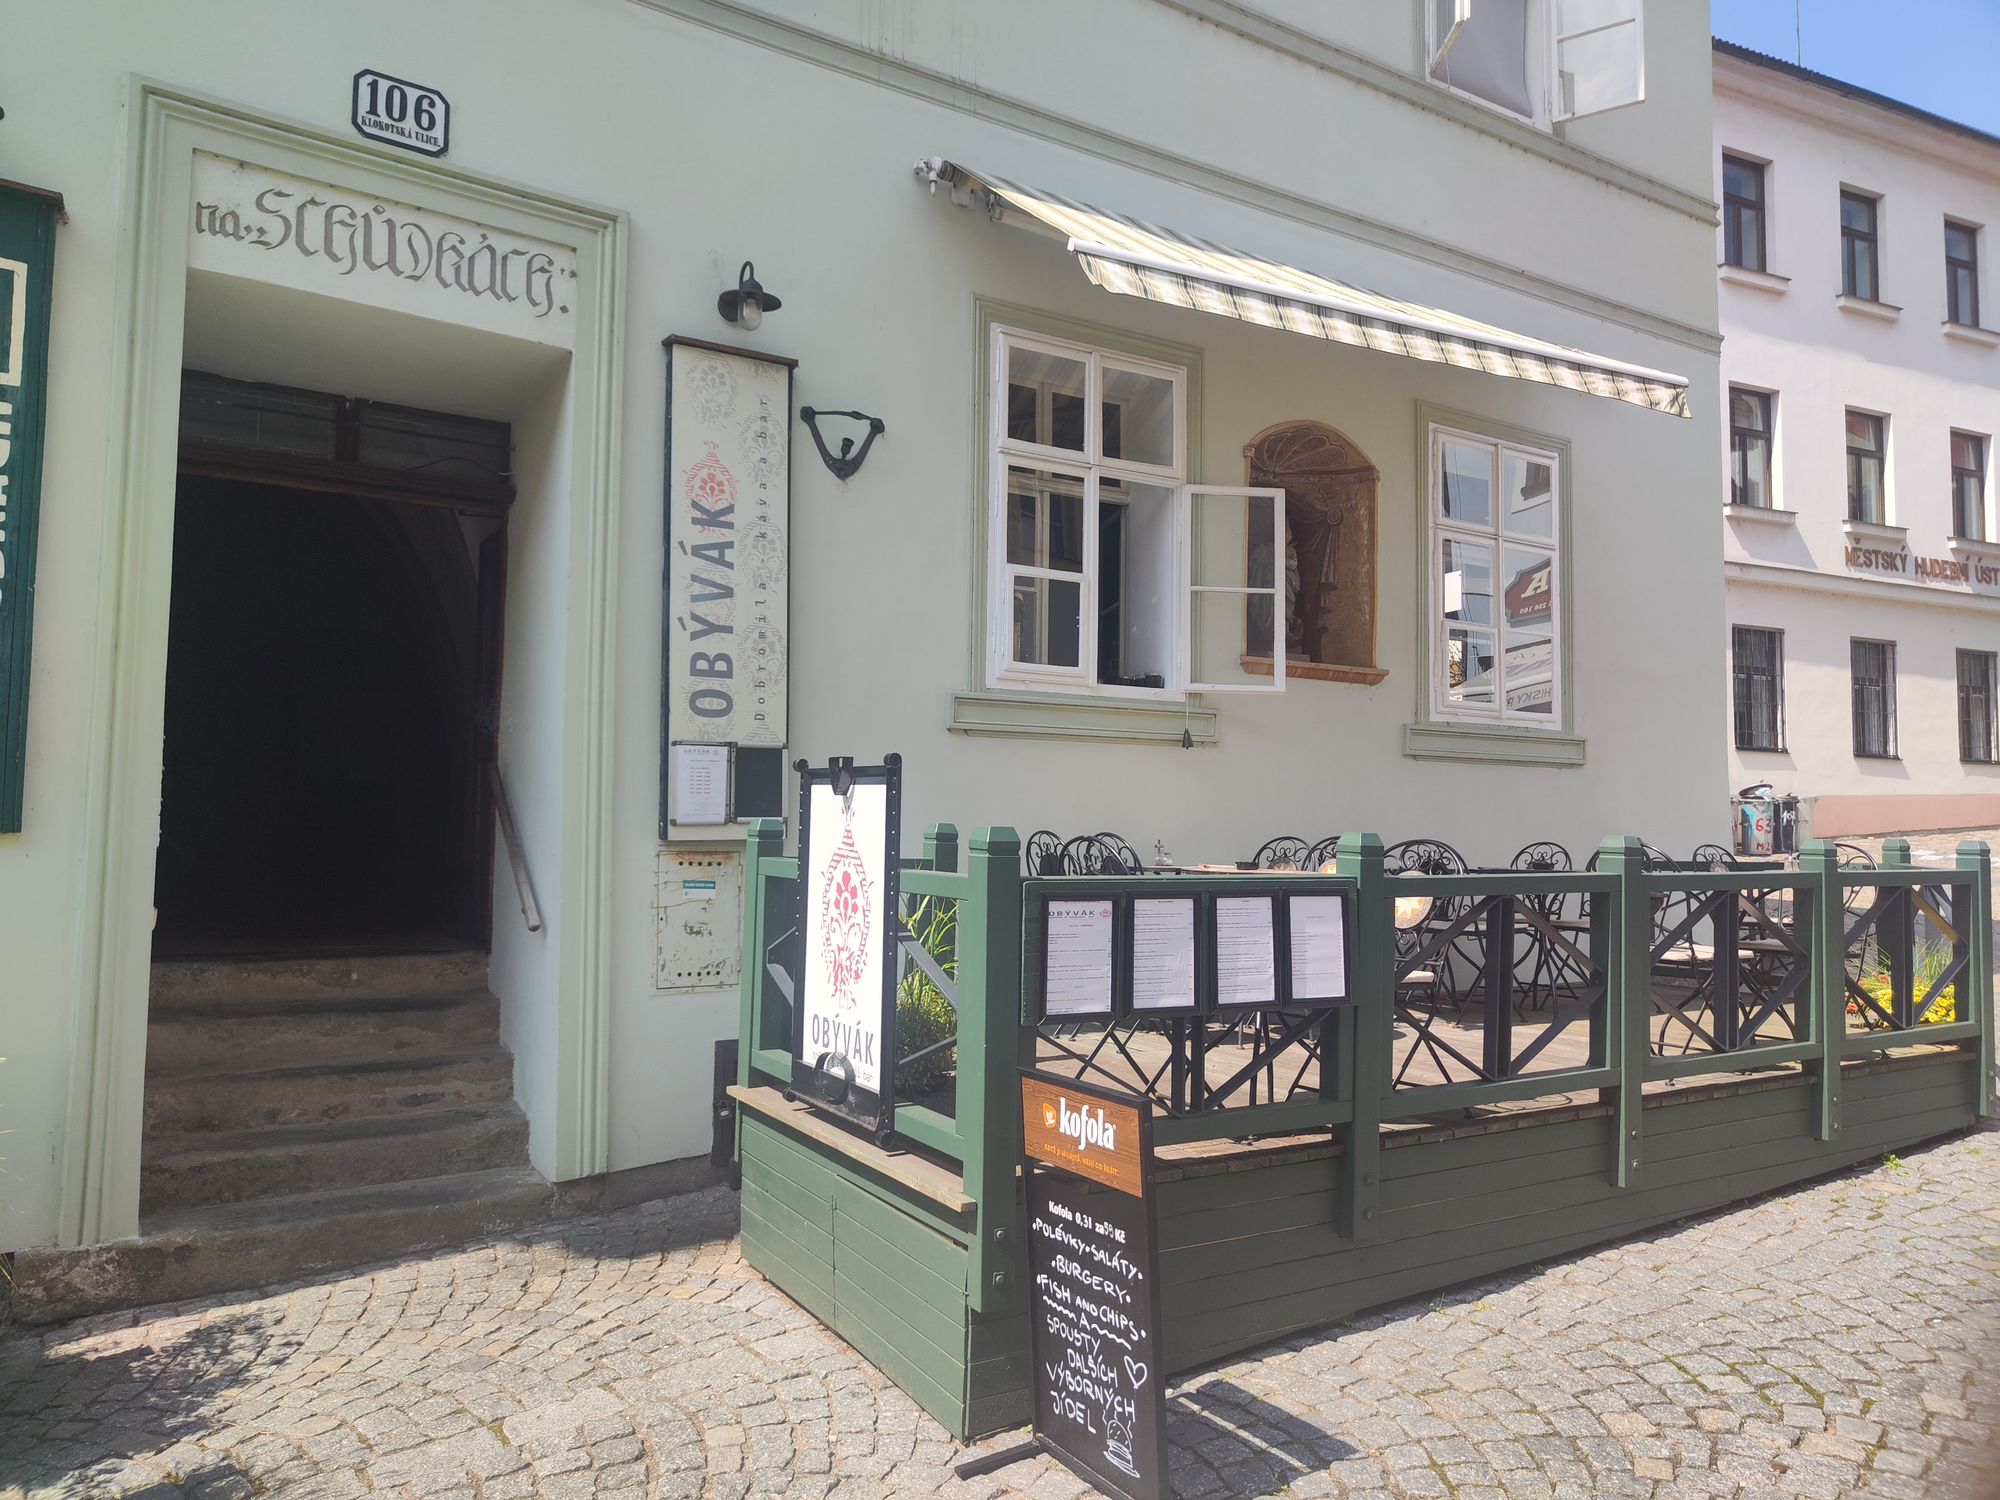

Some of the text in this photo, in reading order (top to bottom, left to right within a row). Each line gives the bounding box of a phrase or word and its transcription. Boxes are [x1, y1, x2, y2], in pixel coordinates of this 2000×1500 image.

[365, 78, 437, 132] 106
[361, 116, 441, 148] KLOKOTSKÁ ULICE.
[757, 398, 768, 440] bar
[755, 482, 768, 540] káva
[1844, 537, 1908, 573] MĚSTSKÝ
[1914, 555, 1970, 583] HUDEBNÍ
[677, 498, 736, 719] OBÝVÁK
[754, 582, 768, 721] Dobromila
[1755, 817, 1773, 834] 63
[1048, 909, 1096, 917] OBÝVÁK
[811, 1012, 874, 1068] OBÝVÁK
[1059, 1096, 1115, 1151] kofola
[1048, 1200, 1073, 1221] Kofola
[1114, 1228, 1126, 1244] Kč
[1040, 1274, 1072, 1304] FISH
[1075, 1295, 1098, 1317] AND
[1056, 1254, 1127, 1305] BURGERY
[1046, 1314, 1101, 1357] SPOUSTY
[1079, 1312, 1091, 1331] A
[1066, 1348, 1119, 1388] DALŠÍCH
[1046, 1360, 1136, 1423] VÝBORNÝCH
[1050, 1390, 1097, 1435] JÍDEL
